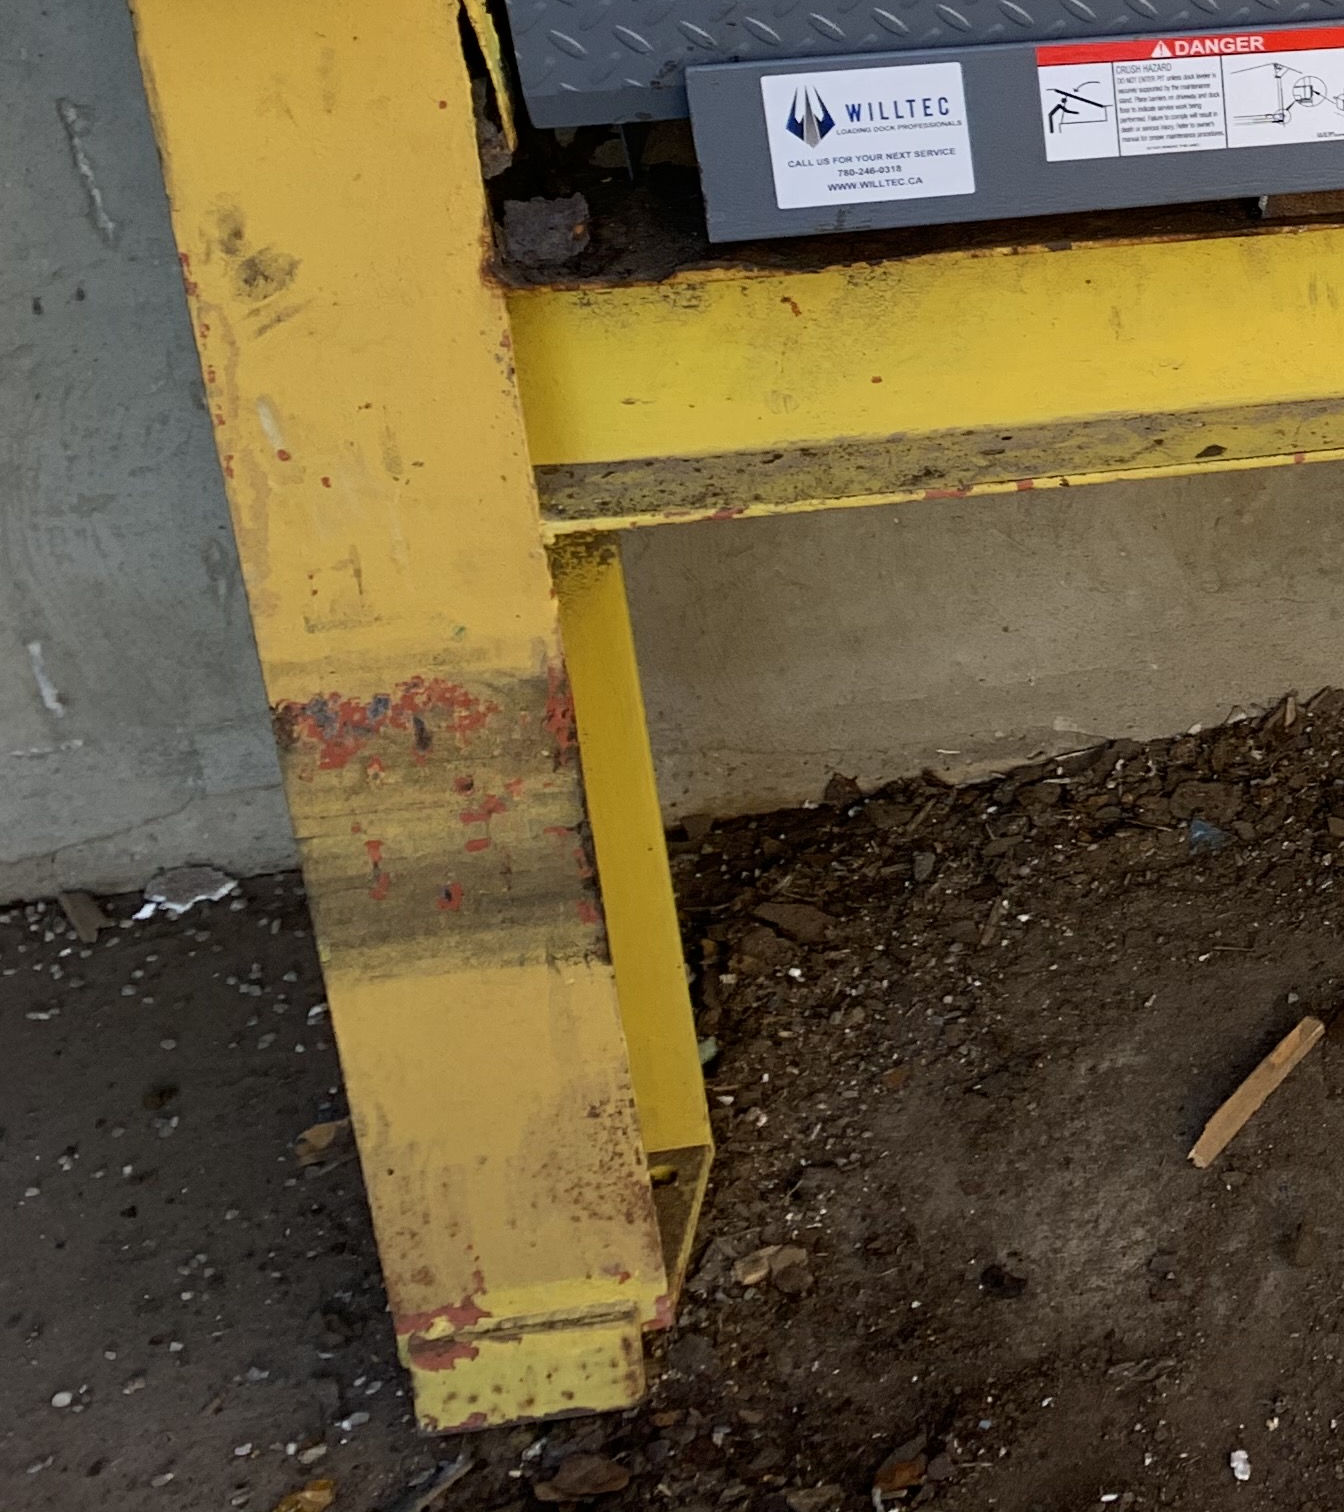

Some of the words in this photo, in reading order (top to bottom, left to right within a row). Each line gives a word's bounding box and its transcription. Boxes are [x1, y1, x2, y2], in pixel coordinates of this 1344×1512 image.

[1175, 36, 1264, 56] DANGER
[1116, 65, 1141, 74] CRUSH
[1143, 63, 1172, 72] HAZARD
[845, 96, 950, 122] WILLTEC
[836, 127, 871, 136] LOADING
[897, 120, 962, 131] PROFESSIONALS
[788, 158, 814, 168] CALL
[817, 157, 830, 166] US
[833, 155, 853, 164] FOR
[855, 153, 884, 163] YOUR
[886, 151, 912, 160] NEXT
[914, 147, 956, 158] SERVICE
[827, 177, 924, 192] WWW.WILLTEC.CA
